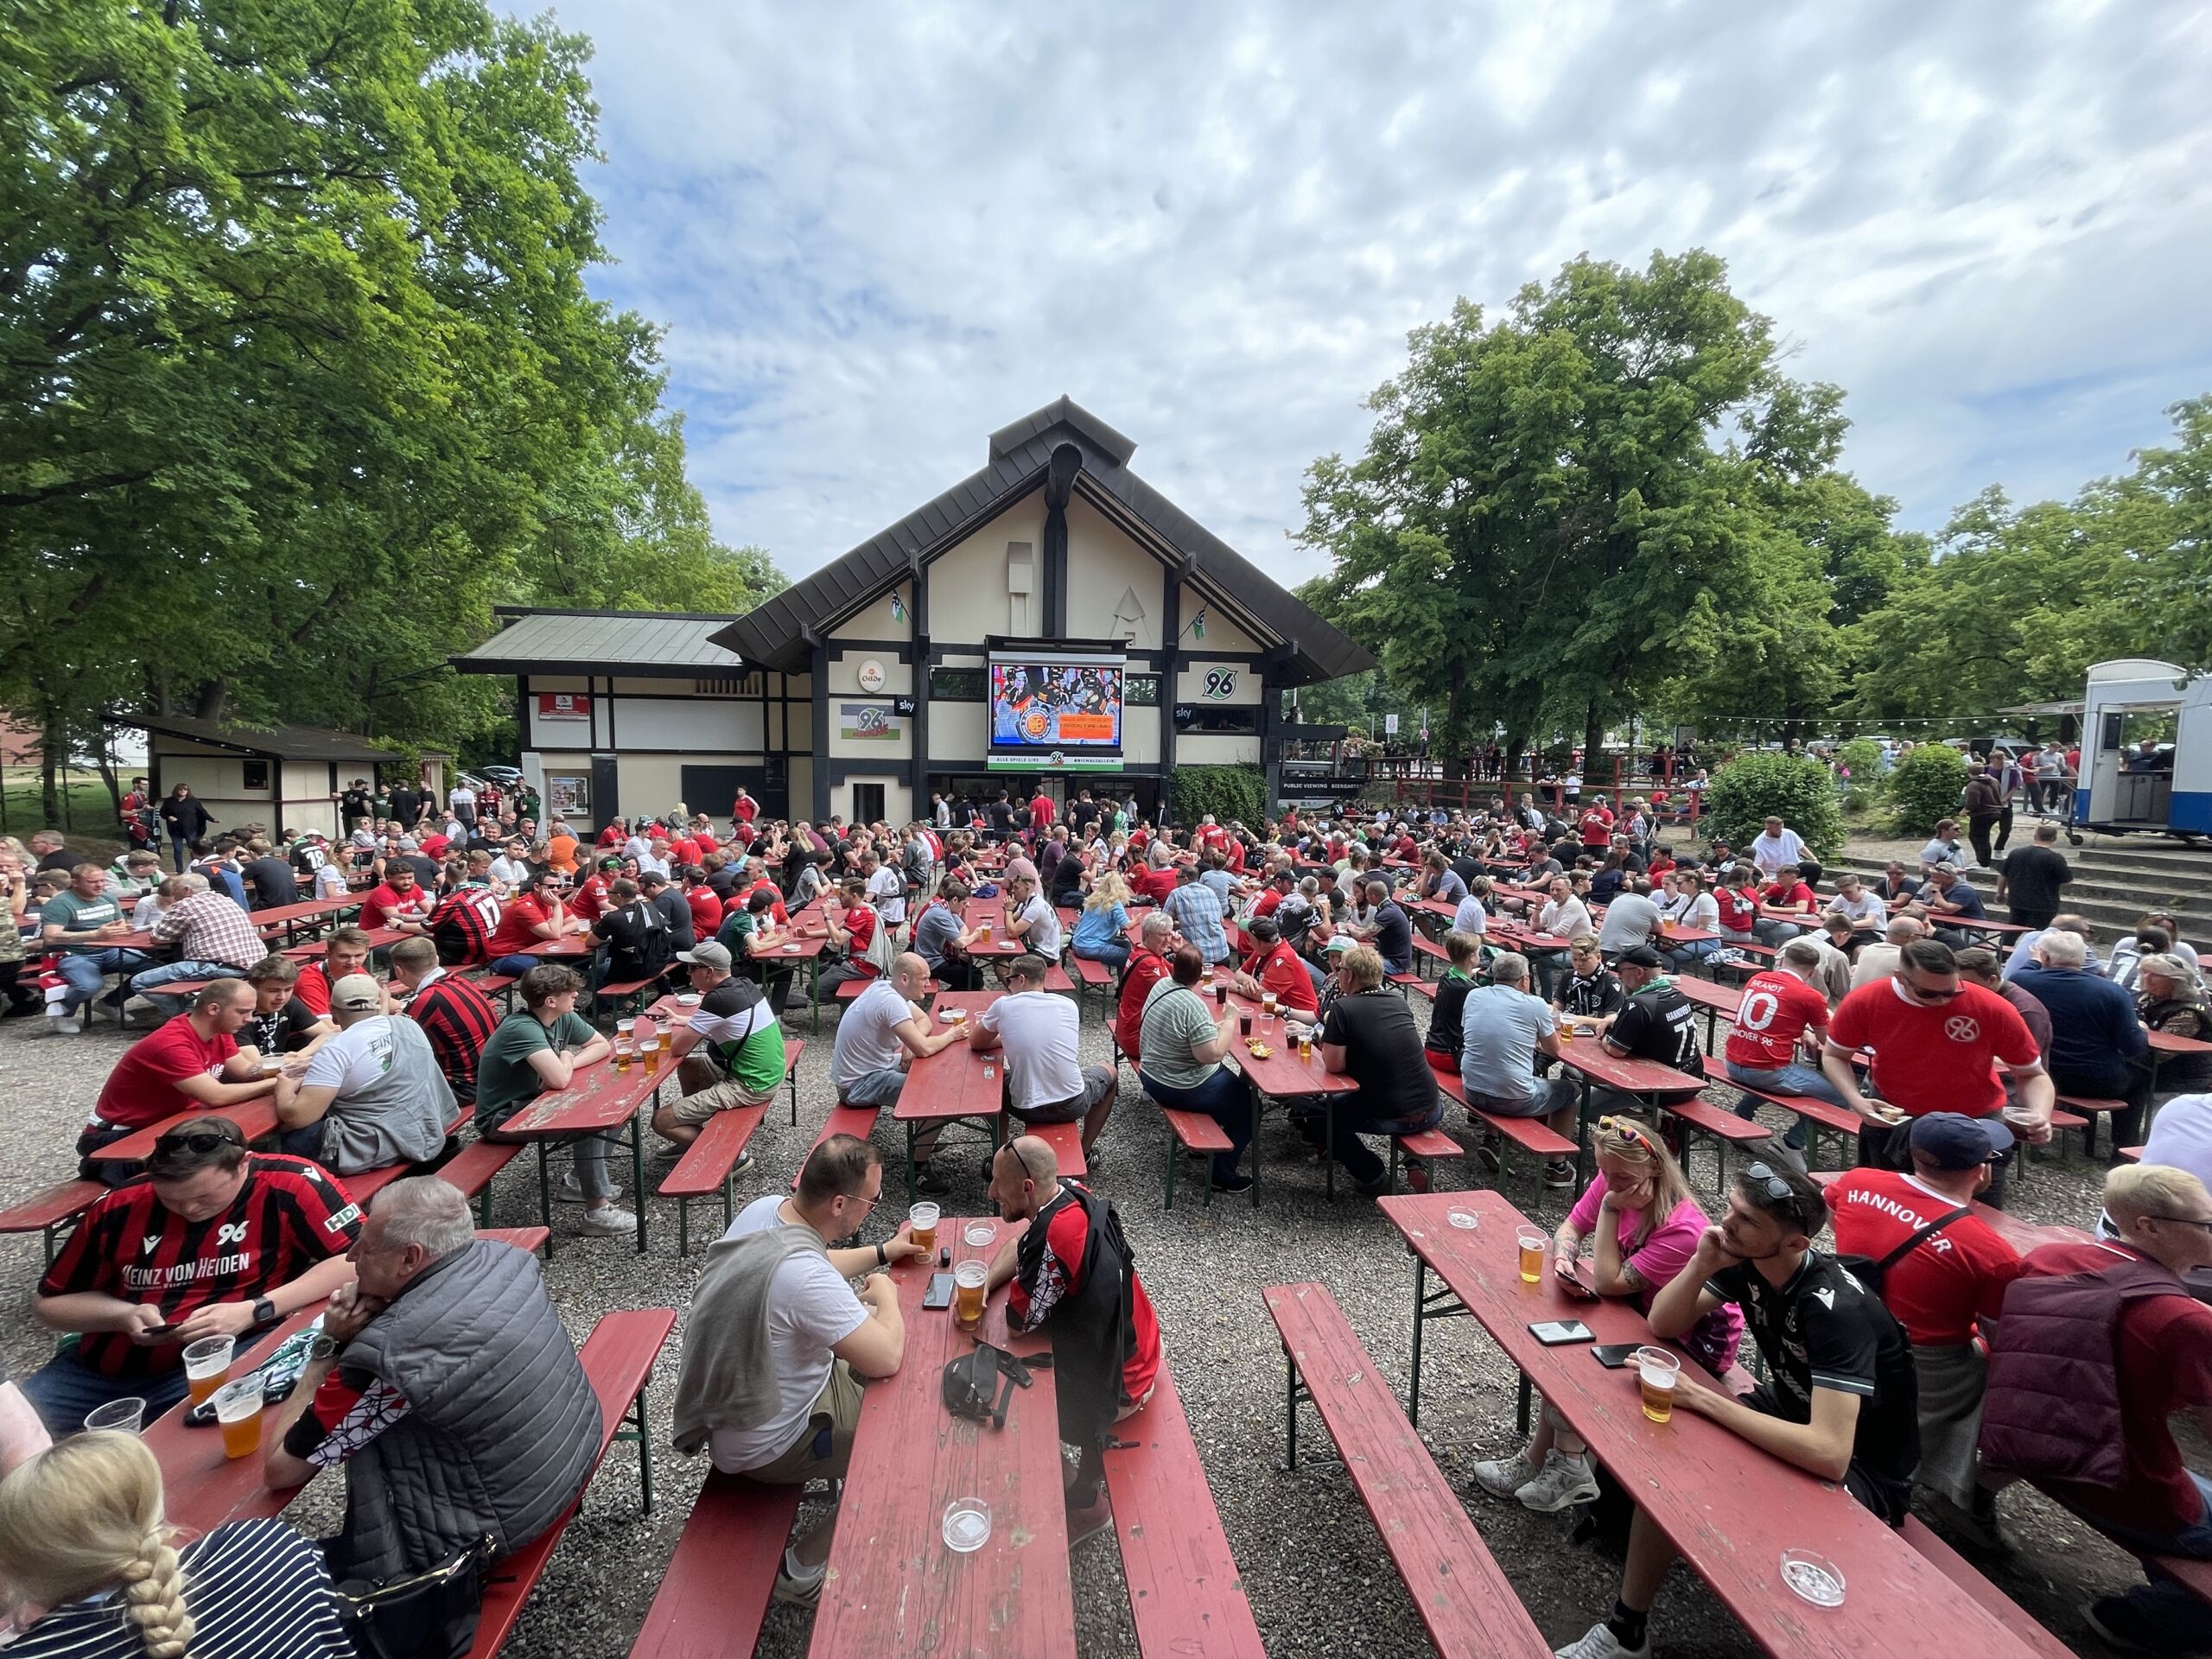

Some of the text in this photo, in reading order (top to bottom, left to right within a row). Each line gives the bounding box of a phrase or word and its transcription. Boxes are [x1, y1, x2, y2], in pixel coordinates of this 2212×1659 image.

[1202, 667, 1238, 700] 96
[899, 699, 915, 713] sky
[1176, 708, 1192, 719] sky
[475, 895, 500, 931] 17
[1751, 979, 1785, 994] BRANDT
[1735, 988, 1778, 1031] 10
[1945, 1015, 1980, 1041] 96
[1761, 1037, 1774, 1046] 96
[327, 1205, 359, 1230] HDI
[216, 1220, 250, 1246] 96
[165, 1262, 195, 1283] VON
[196, 1252, 250, 1279] HEIDEN
